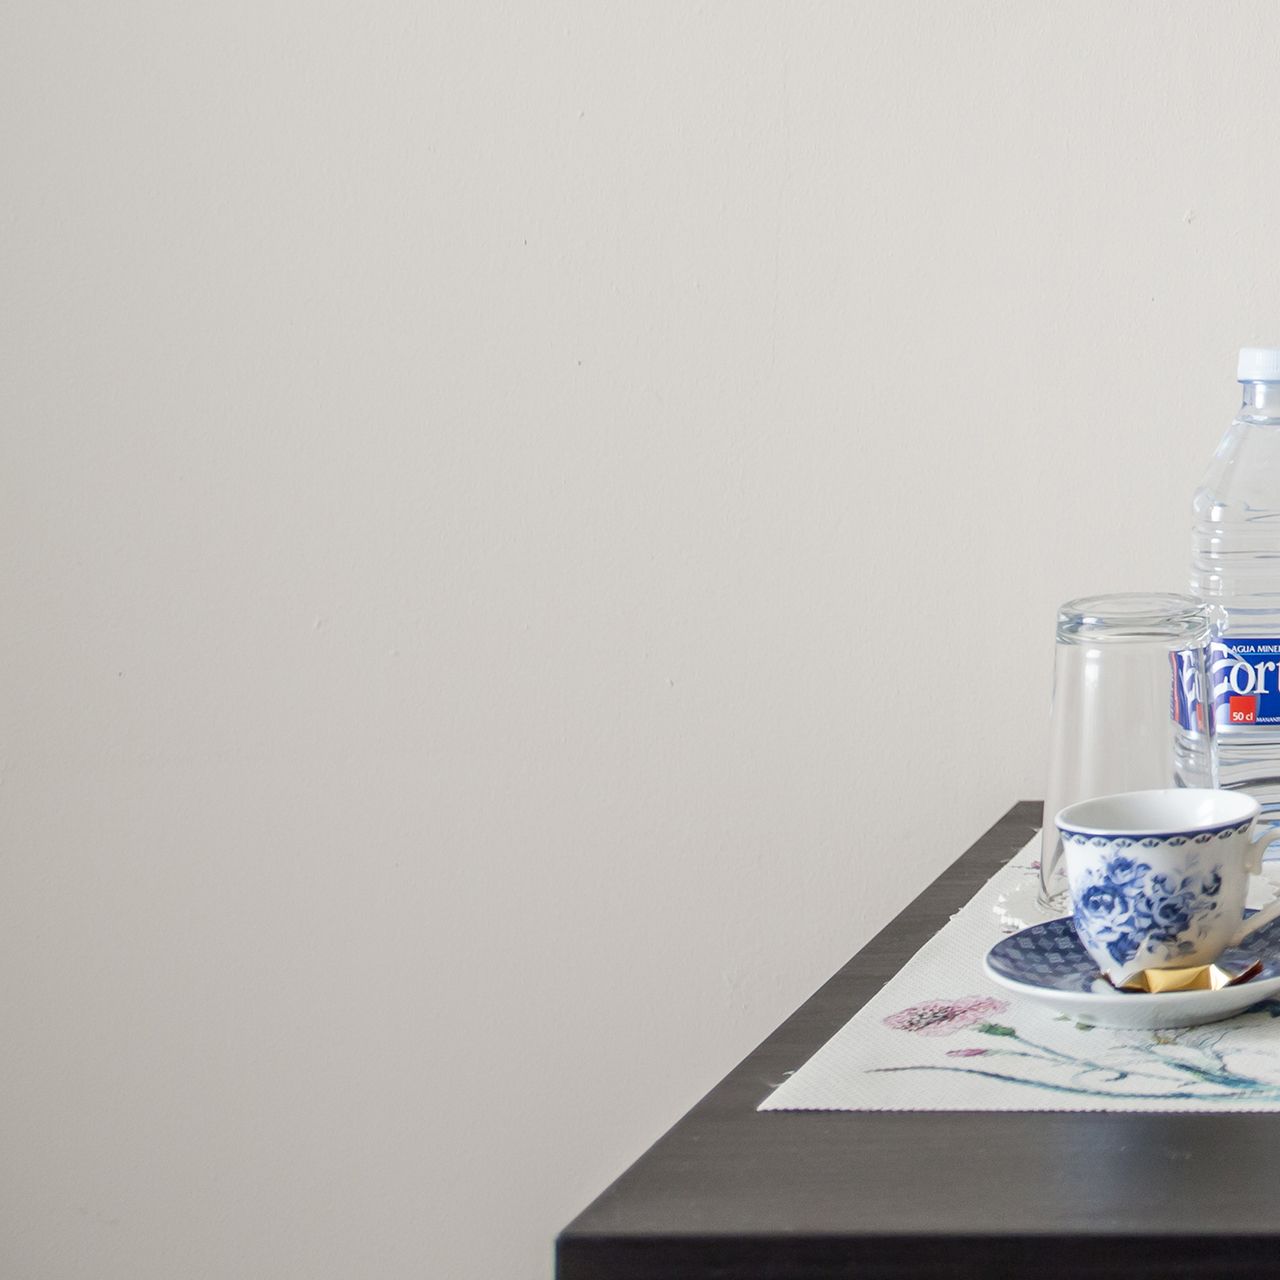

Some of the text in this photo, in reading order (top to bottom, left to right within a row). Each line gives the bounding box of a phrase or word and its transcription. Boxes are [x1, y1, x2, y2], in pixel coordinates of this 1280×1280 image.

[1231, 645, 1256, 653] AGUA
[1232, 711, 1254, 721] 50 cl
